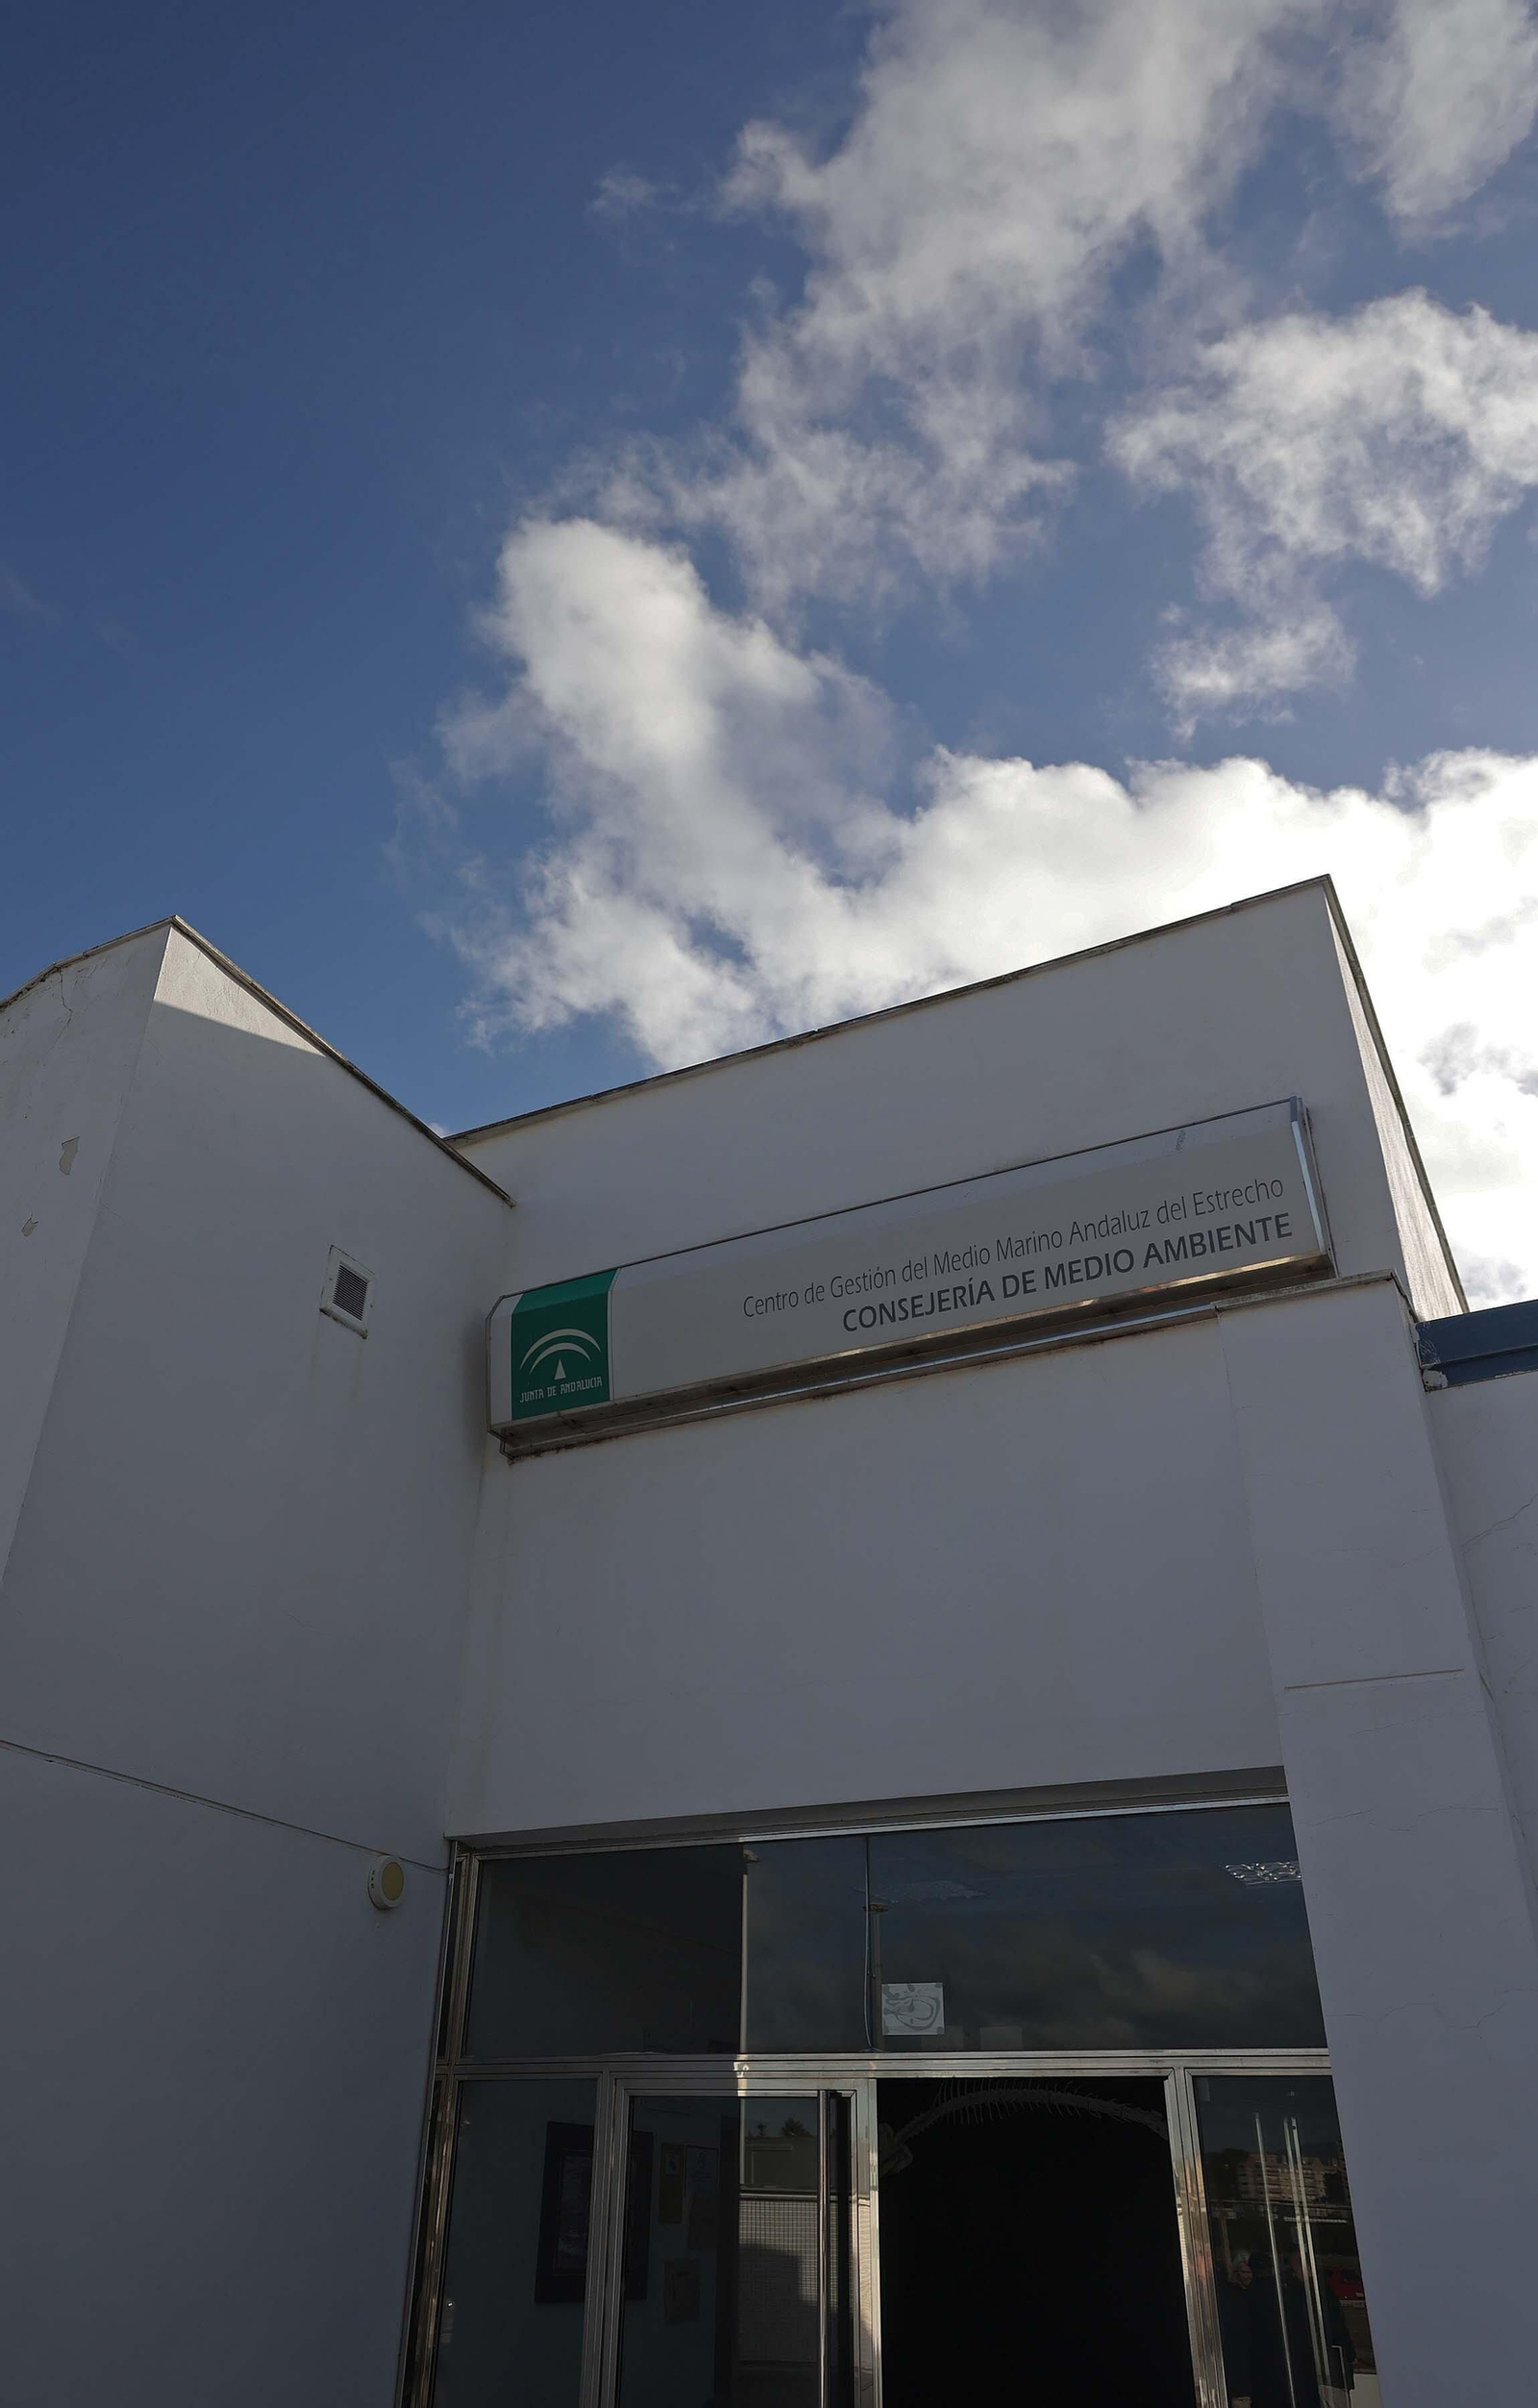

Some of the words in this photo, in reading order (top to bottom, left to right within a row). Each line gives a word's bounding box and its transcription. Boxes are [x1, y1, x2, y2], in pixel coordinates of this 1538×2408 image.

[743, 1290, 799, 1317] Centro
[804, 1281, 825, 1304] de
[830, 1266, 896, 1299] Gestión
[902, 1256, 929, 1282] del
[934, 1245, 990, 1277] Medio
[996, 1230, 1062, 1261] Marino
[1069, 1209, 1151, 1245] Andaluz
[1156, 1196, 1187, 1225] del
[1192, 1179, 1284, 1216] Estrecho
[843, 1278, 996, 1332] CONSEJERÍA
[1002, 1269, 1037, 1299] DE
[1044, 1248, 1135, 1290] MEDIO
[1142, 1212, 1294, 1269] AMBIENTE
[519, 1388, 545, 1403] JUNTA
[546, 1385, 558, 1398] DE
